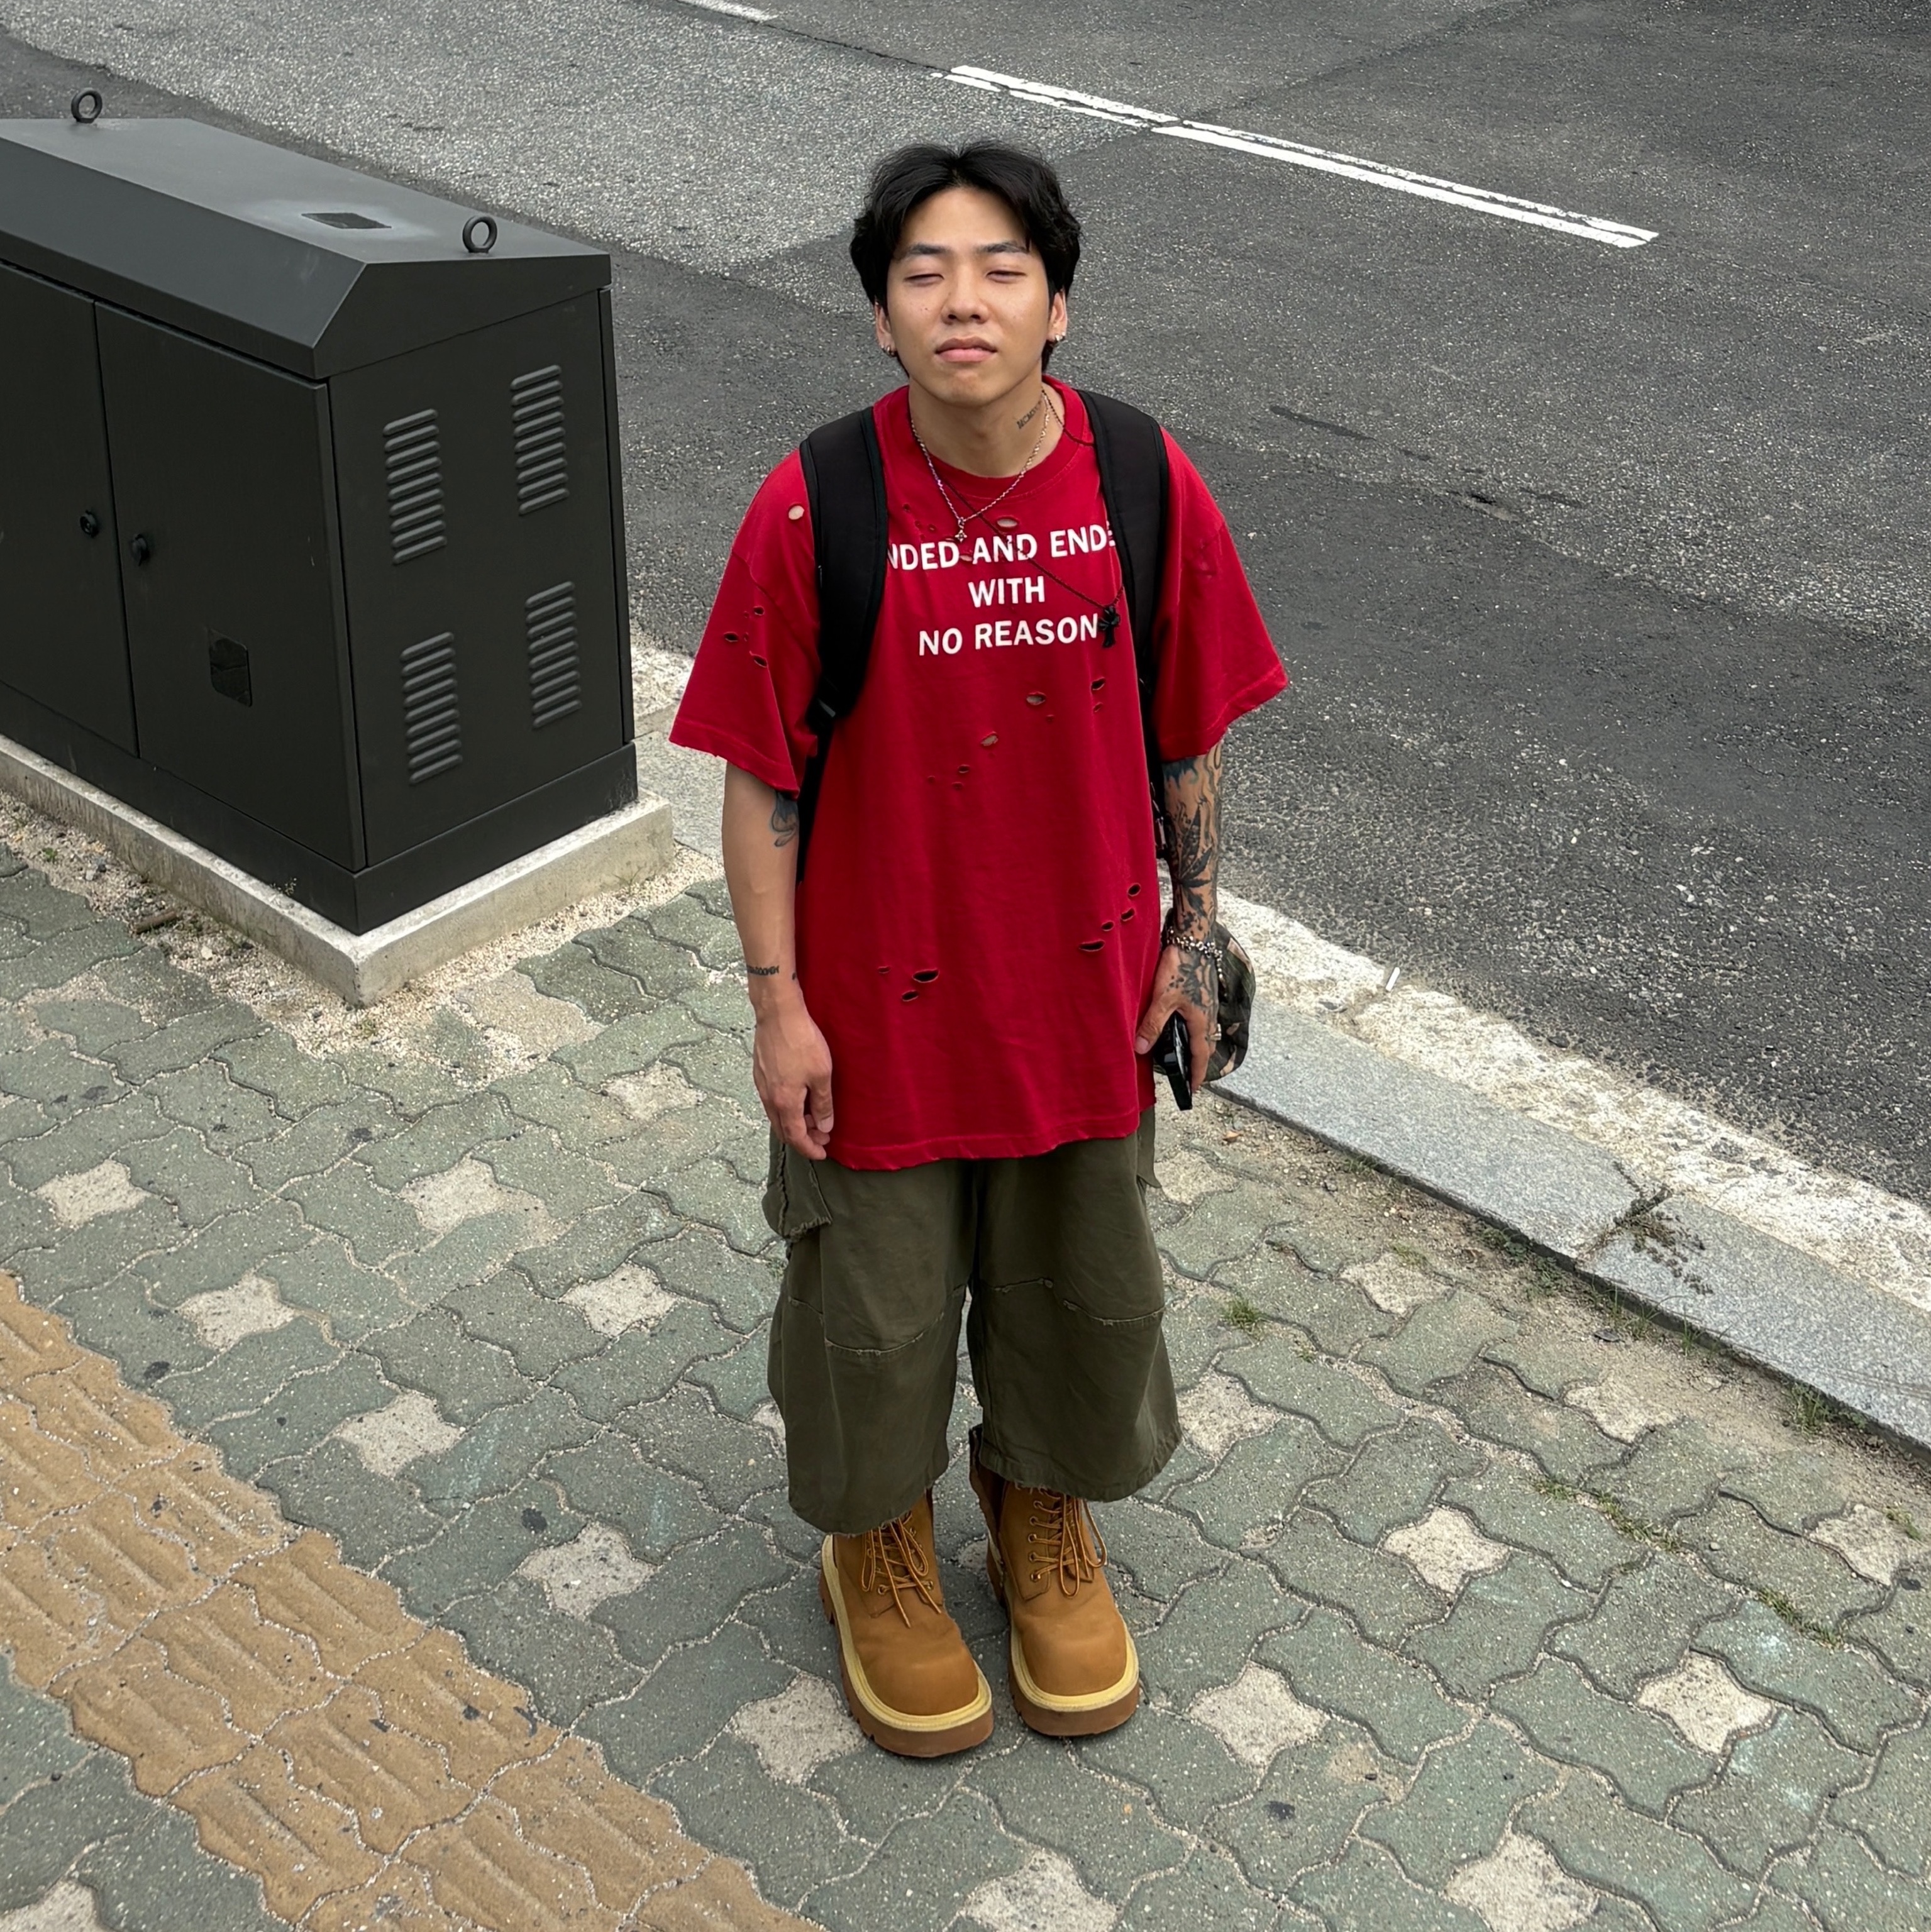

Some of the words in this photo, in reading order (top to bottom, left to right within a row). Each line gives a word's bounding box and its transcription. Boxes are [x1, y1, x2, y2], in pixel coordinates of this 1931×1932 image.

[972, 533, 1037, 565] AND
[968, 575, 1045, 608] WITH
[919, 627, 963, 656] NO
[975, 613, 1098, 649] REASON
